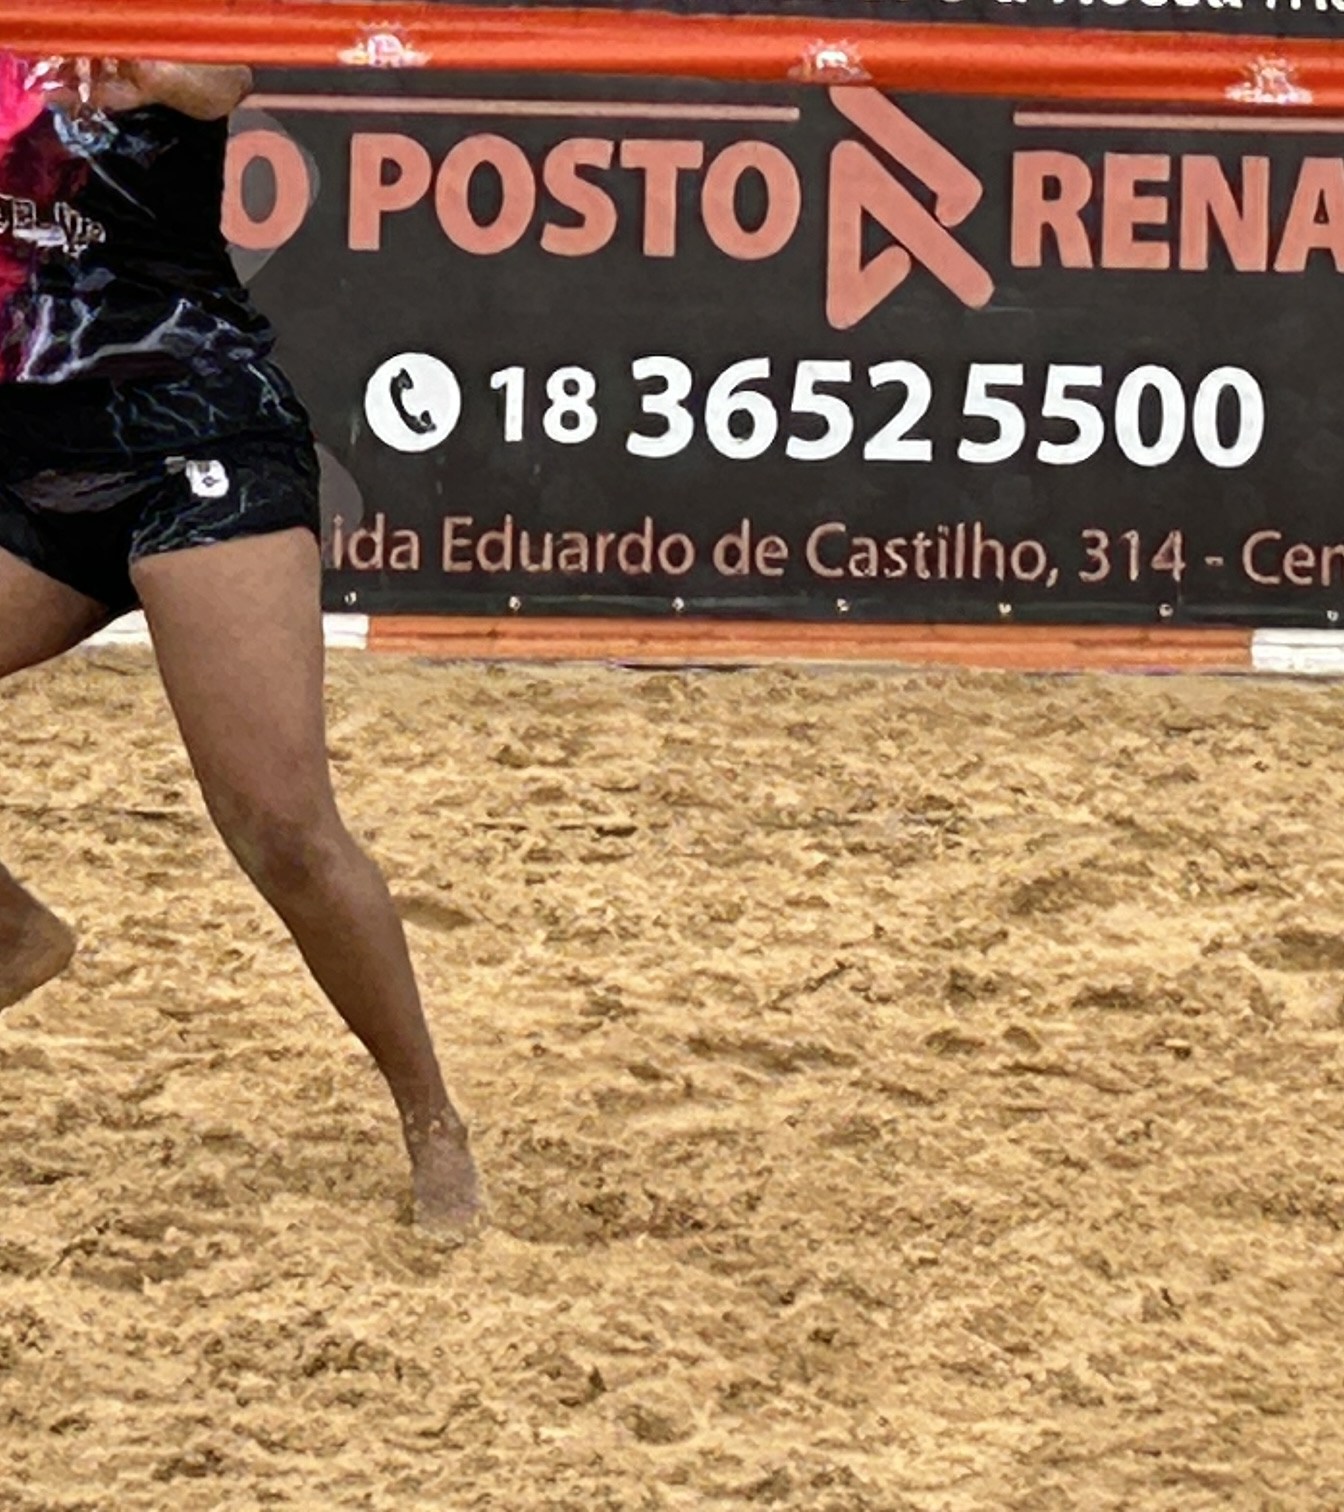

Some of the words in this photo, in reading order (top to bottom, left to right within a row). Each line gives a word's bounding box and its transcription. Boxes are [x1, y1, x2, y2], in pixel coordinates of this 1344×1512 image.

[348, 133, 801, 260] POSTO
[490, 365, 599, 444] 18
[626, 355, 933, 462] 3652
[957, 363, 1265, 468] 5500
[332, 513, 420, 570] ida
[442, 514, 695, 575] Eduardo
[713, 518, 789, 576] de
[806, 521, 1059, 587] Castilho,
[1079, 529, 1186, 582] 314
